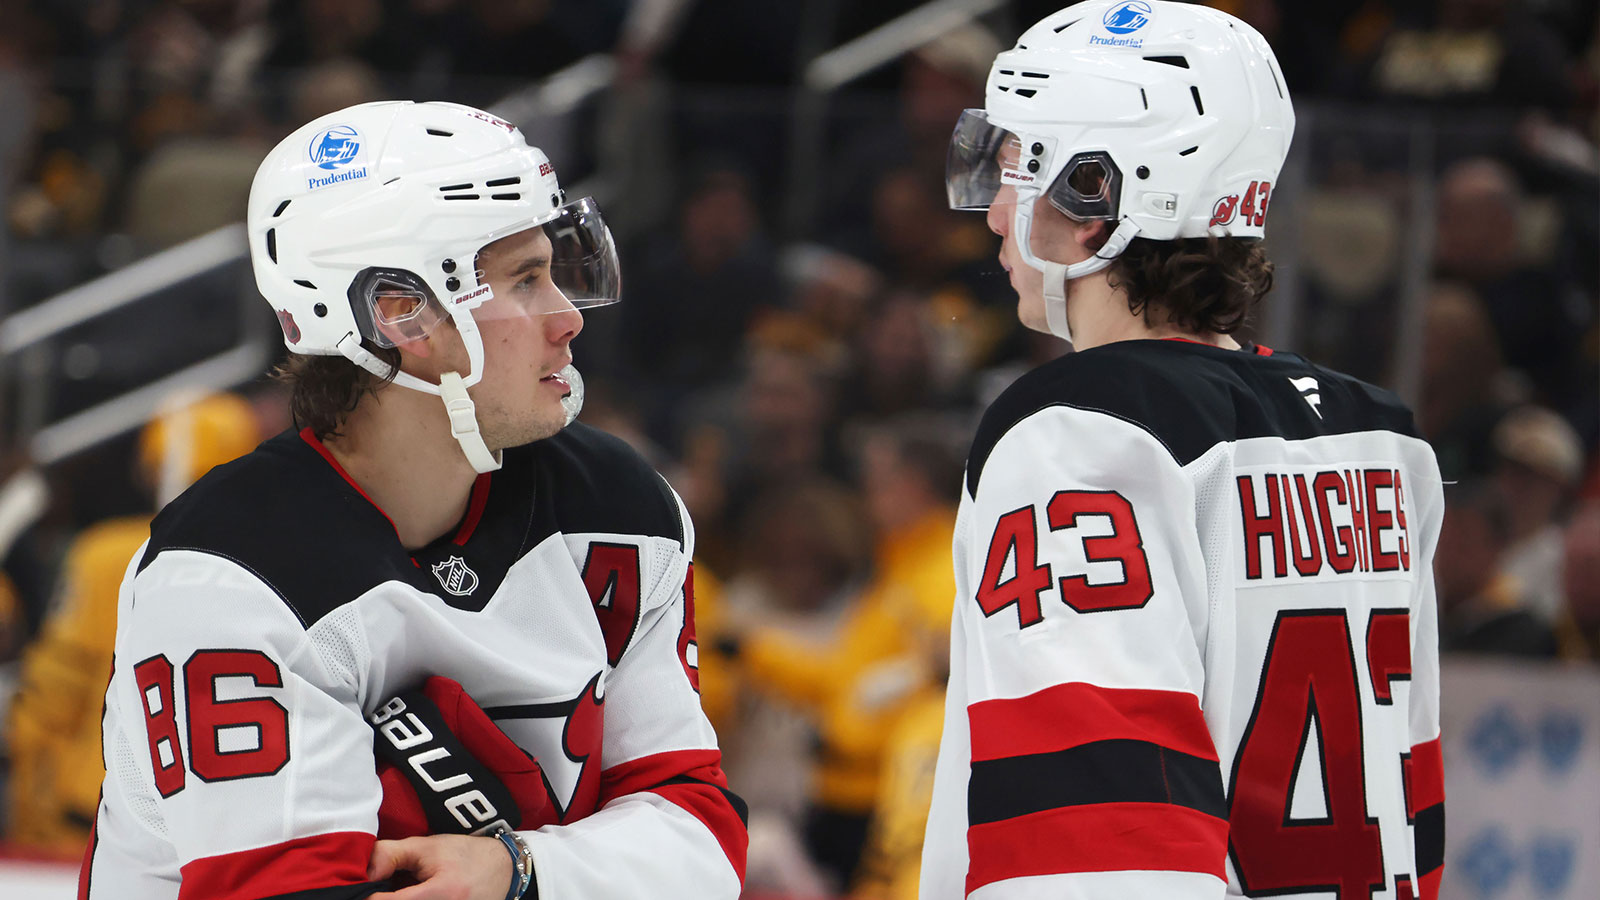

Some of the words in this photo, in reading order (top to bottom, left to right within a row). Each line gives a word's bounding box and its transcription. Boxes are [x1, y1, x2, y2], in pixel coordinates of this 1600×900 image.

[1089, 35, 1143, 48] Prudential
[308, 167, 367, 189] Prudential
[1240, 181, 1270, 226] 43
[456, 287, 489, 304] BAUER
[1236, 468, 1411, 580] HUGHES
[449, 568, 462, 590] NHL
[975, 489, 1154, 630] 43
[581, 541, 640, 668] A
[134, 648, 290, 798] 86
